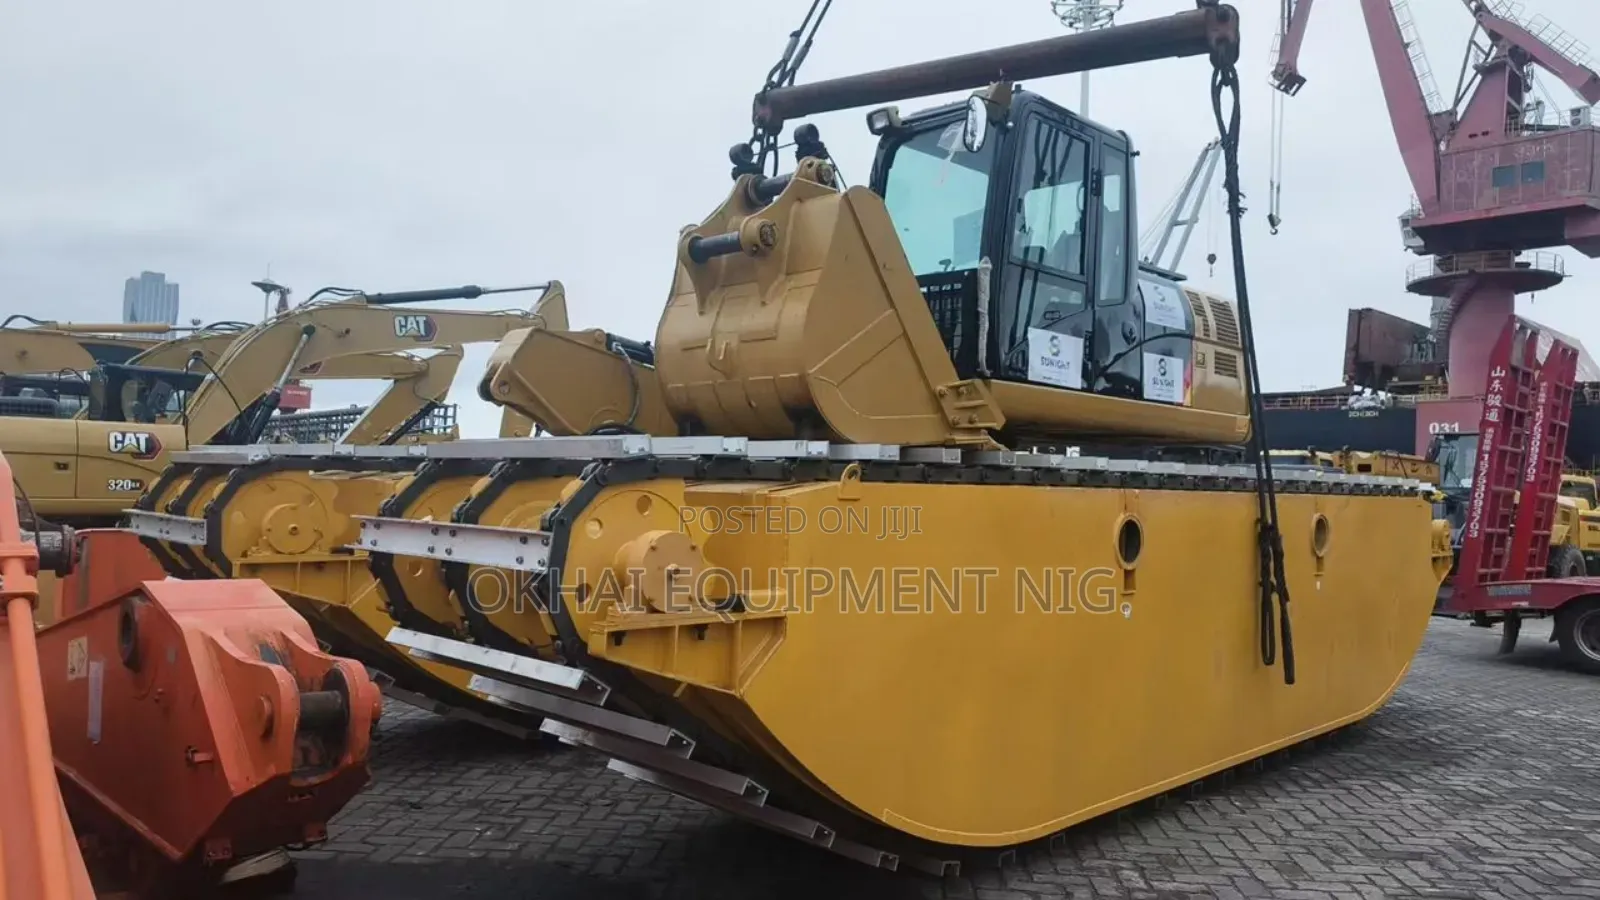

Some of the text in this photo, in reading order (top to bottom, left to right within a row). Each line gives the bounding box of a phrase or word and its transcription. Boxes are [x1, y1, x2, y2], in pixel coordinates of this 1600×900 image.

[394, 316, 426, 337] CAT
[109, 431, 149, 454] CAT
[108, 479, 131, 491] 320
